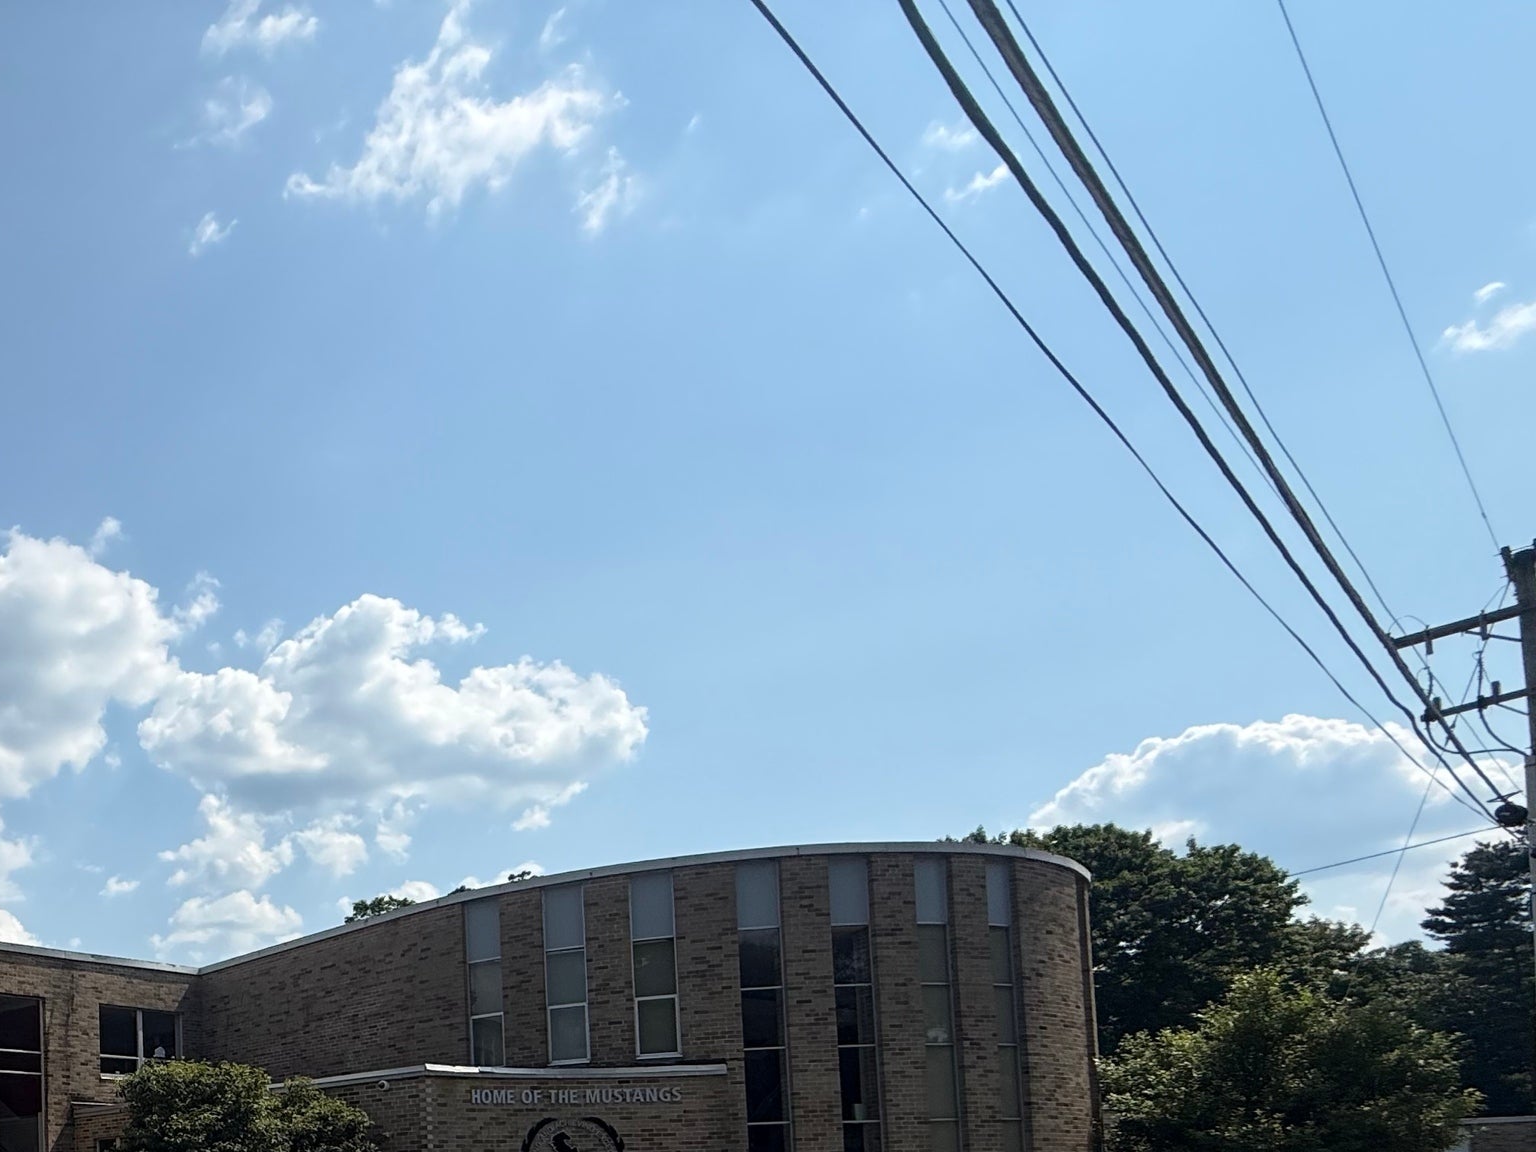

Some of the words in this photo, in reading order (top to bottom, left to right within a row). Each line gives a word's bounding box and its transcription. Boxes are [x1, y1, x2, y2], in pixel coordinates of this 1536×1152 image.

[471, 1089, 515, 1105] HOME
[521, 1089, 543, 1104] OF
[549, 1089, 579, 1104] THE
[586, 1086, 682, 1104] MUSTANGS
